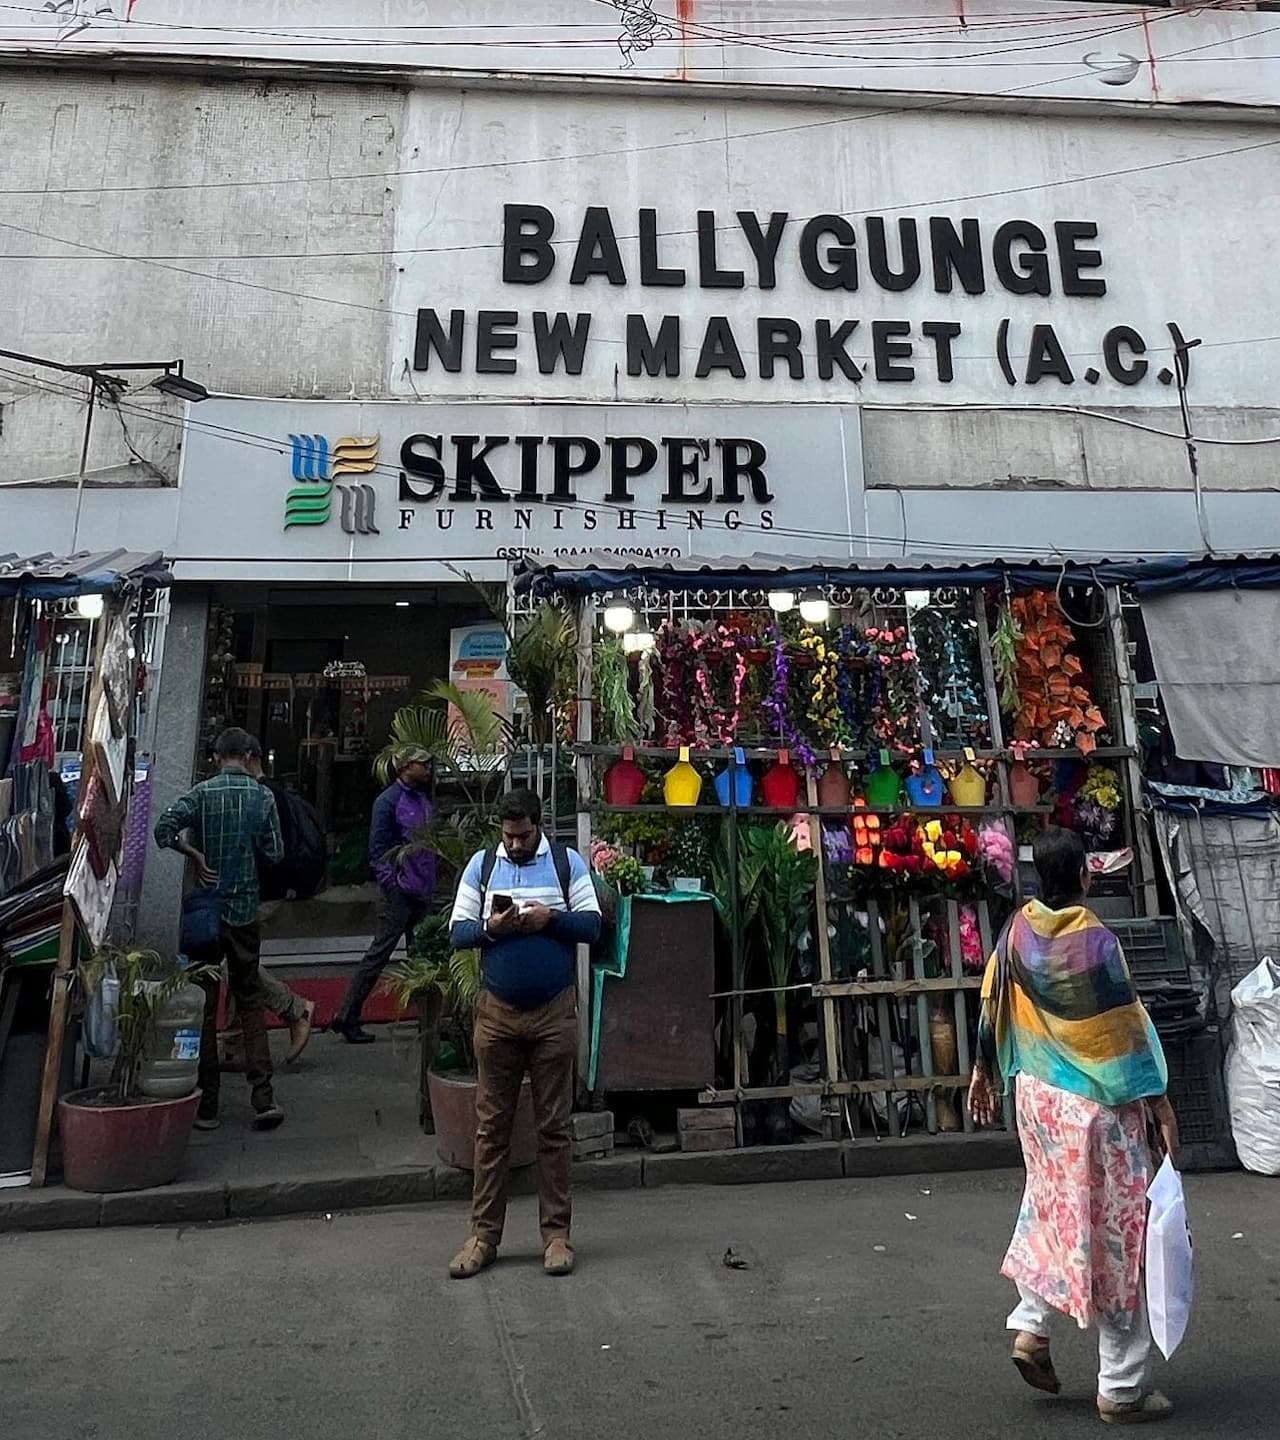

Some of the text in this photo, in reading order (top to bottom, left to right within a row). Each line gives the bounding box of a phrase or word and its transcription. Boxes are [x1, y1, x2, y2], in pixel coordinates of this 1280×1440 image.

[501, 203, 1108, 297] BALLYGUNGE
[413, 307, 1194, 389] NEW MARKET (A.C.)
[398, 433, 775, 505] SKIPPER
[399, 508, 777, 531] FURNISHINGS
